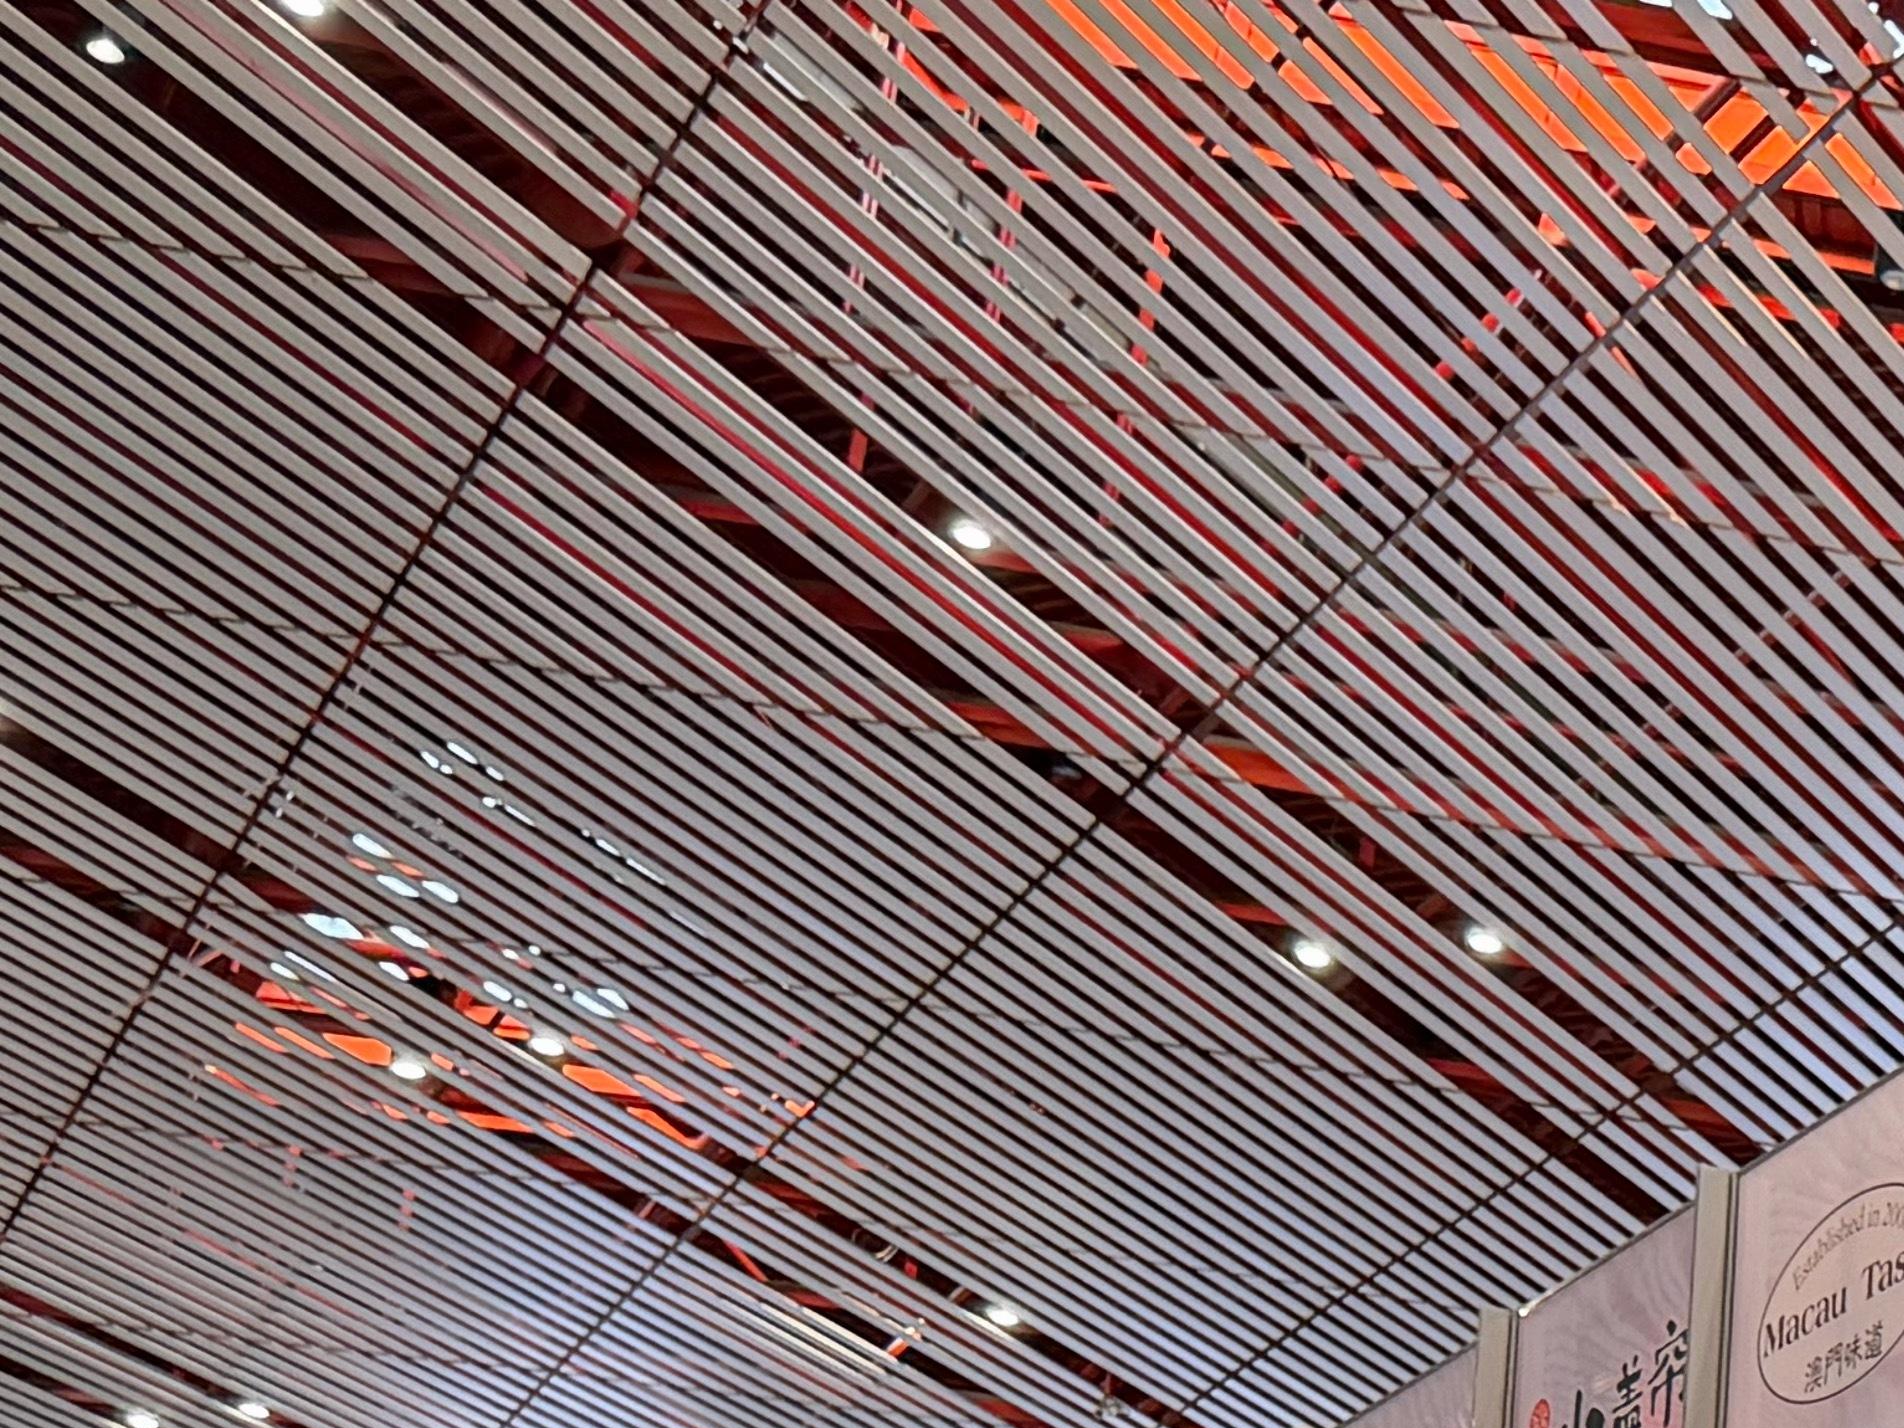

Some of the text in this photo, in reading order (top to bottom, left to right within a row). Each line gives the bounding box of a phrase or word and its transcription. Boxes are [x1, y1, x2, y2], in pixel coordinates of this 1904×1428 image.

[1764, 1286, 1848, 1358] Macau
[1804, 1320, 1883, 1393] 澳門味道
